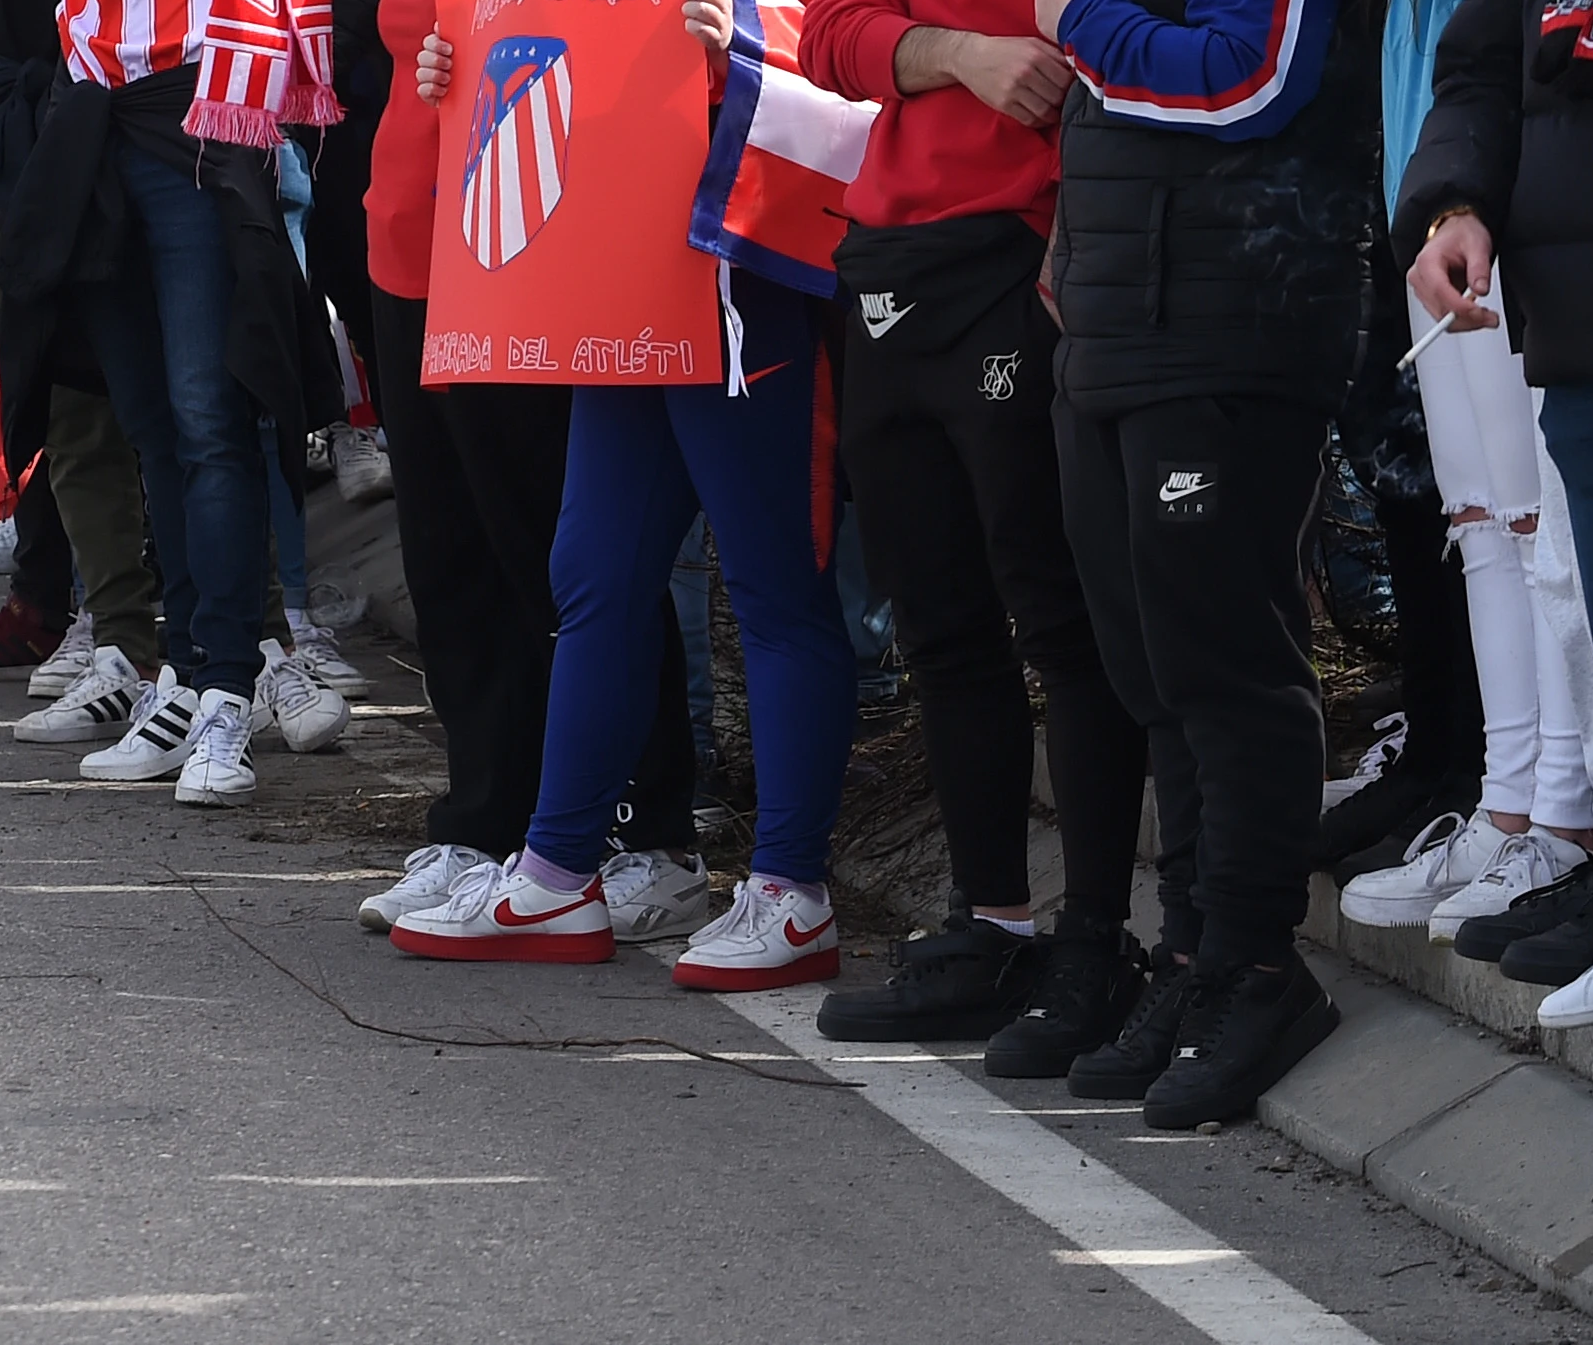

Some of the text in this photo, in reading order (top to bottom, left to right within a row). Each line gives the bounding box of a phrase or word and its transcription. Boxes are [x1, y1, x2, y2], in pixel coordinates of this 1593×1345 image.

[859, 291, 897, 320] NIKE
[507, 335, 559, 371] DEL
[570, 326, 694, 376] ATLÉTI
[1167, 471, 1204, 489] NIKE
[1166, 503, 1204, 513] AIR
